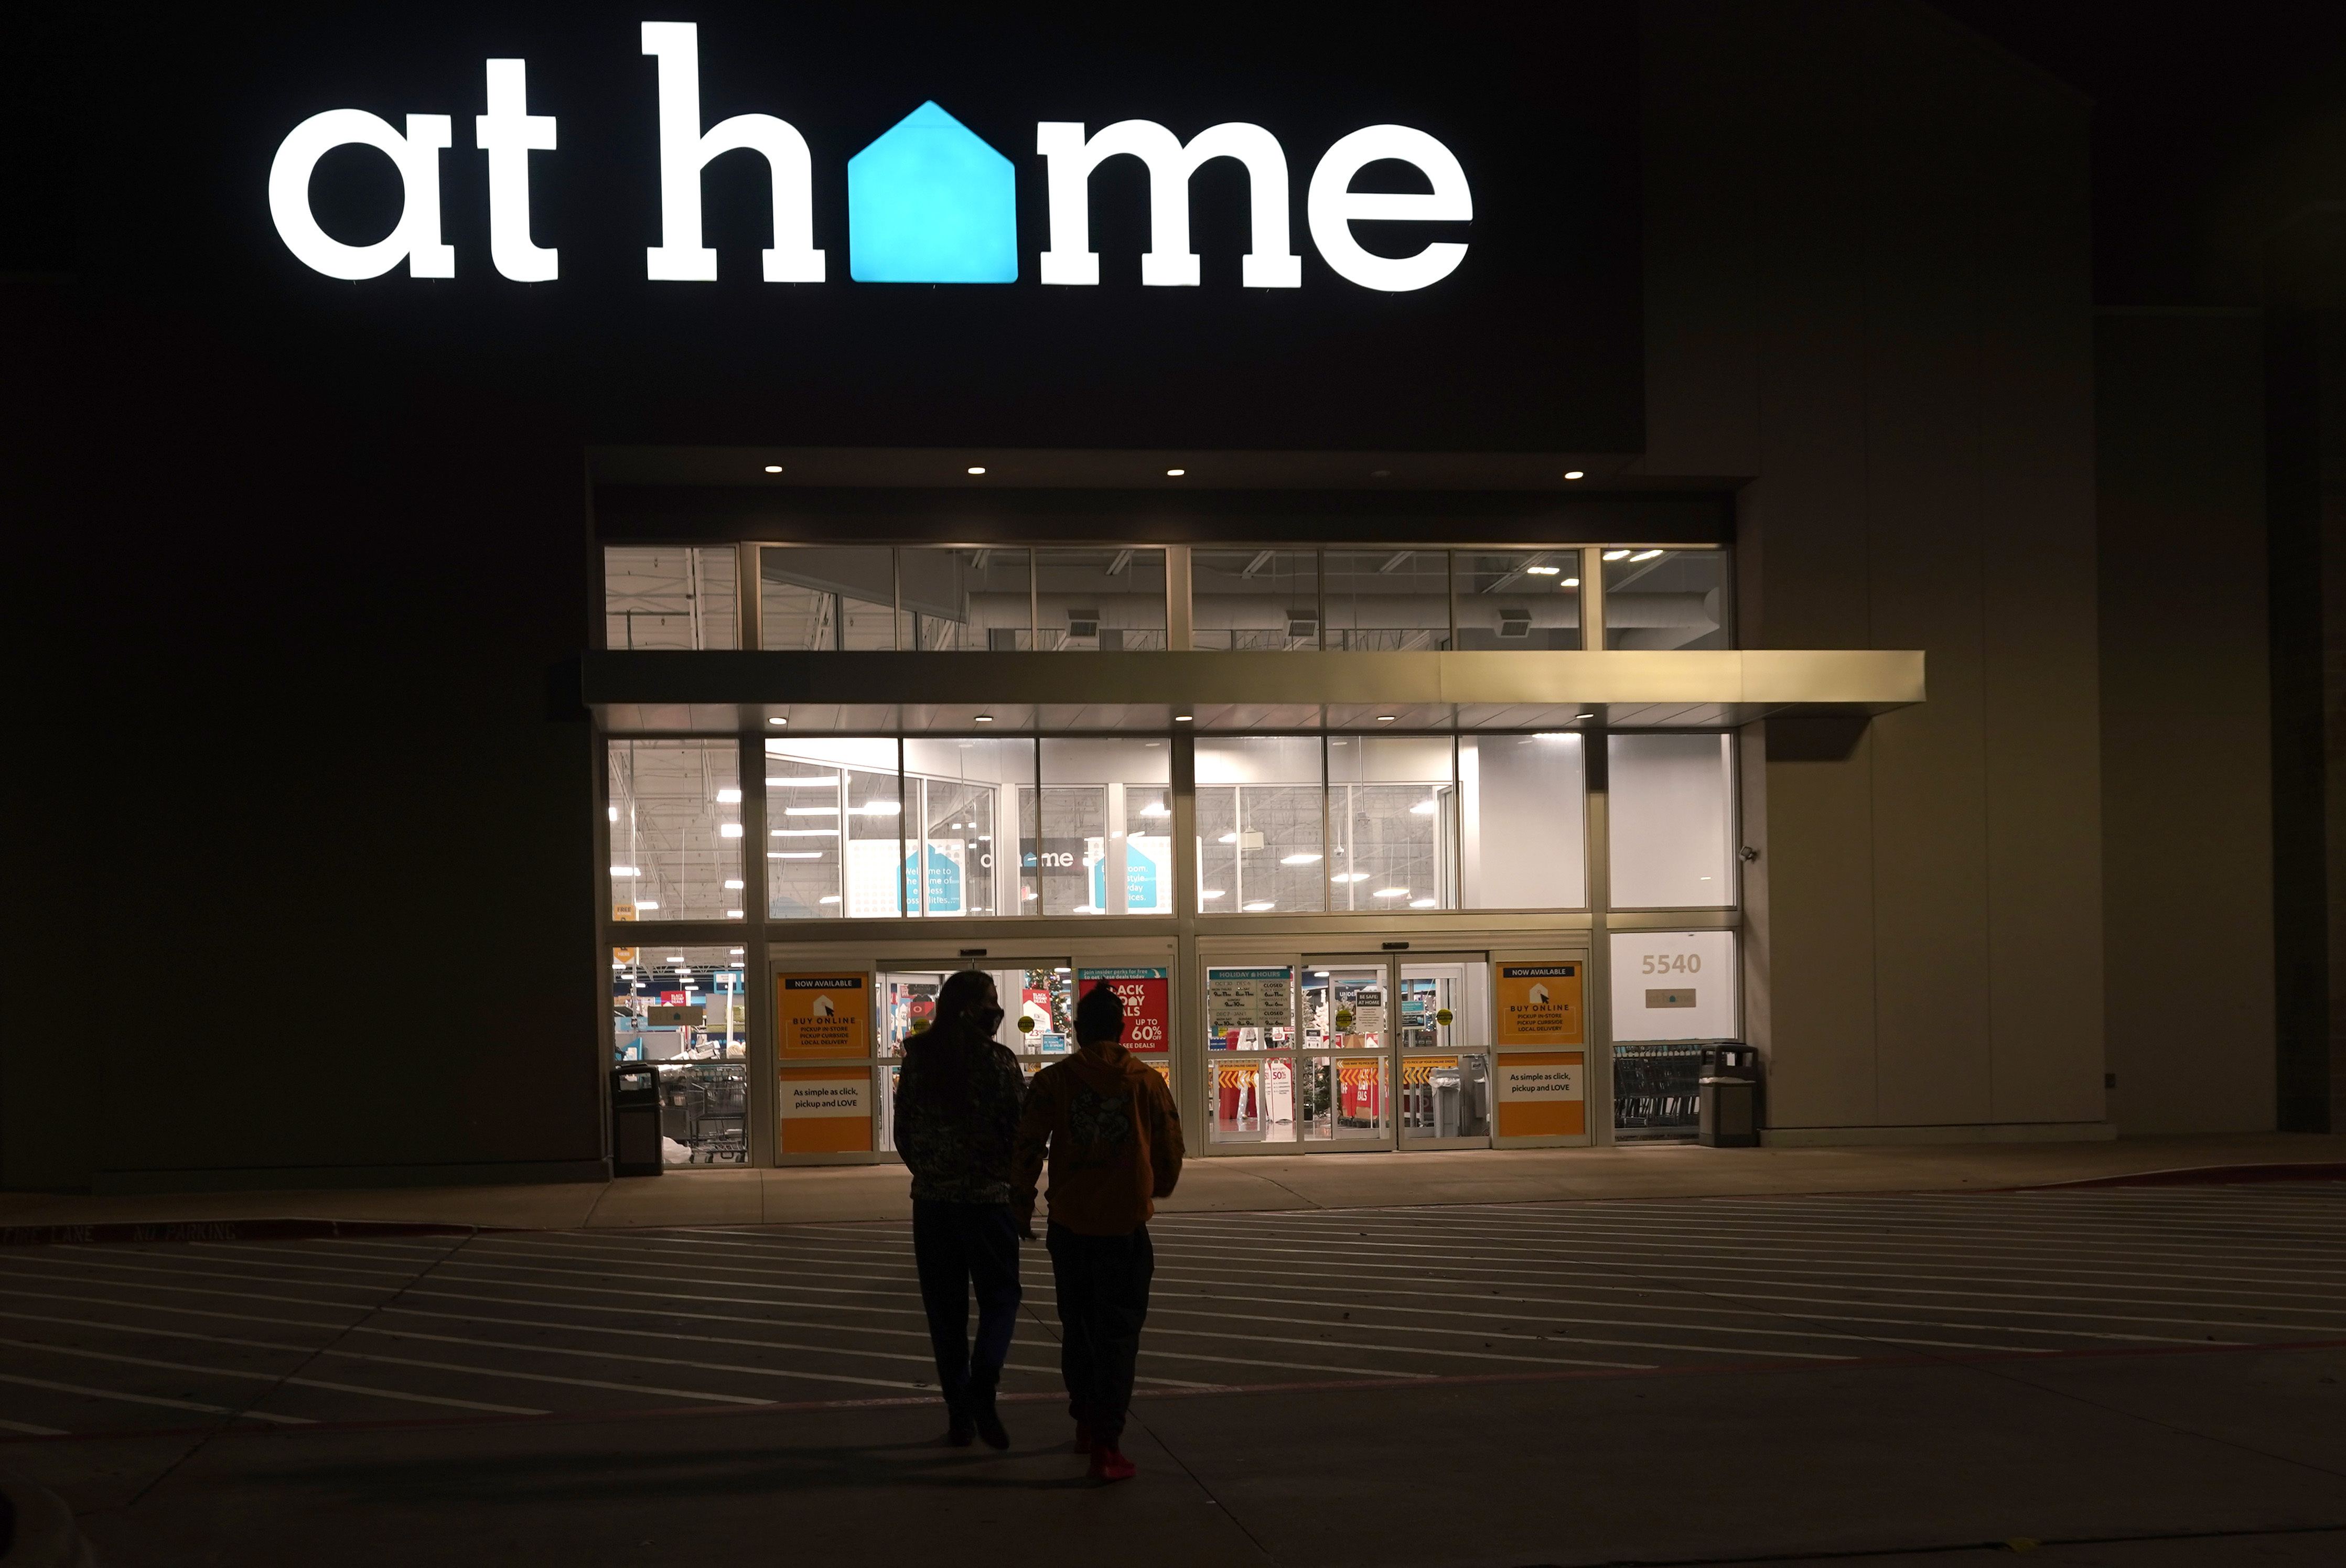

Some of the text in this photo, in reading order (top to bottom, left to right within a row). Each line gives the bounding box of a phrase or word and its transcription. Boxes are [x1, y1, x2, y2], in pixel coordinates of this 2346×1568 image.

[269, 59, 558, 282] at
[1642, 954, 1701, 974] 5540
[1110, 985, 1145, 995] LACK
[1132, 1026, 1161, 1041] 60%
[1520, 1073, 1543, 1082] simple
[804, 1088, 828, 1097] simple
[1512, 1085, 1535, 1093] pickup
[795, 1100, 821, 1109] pickup
